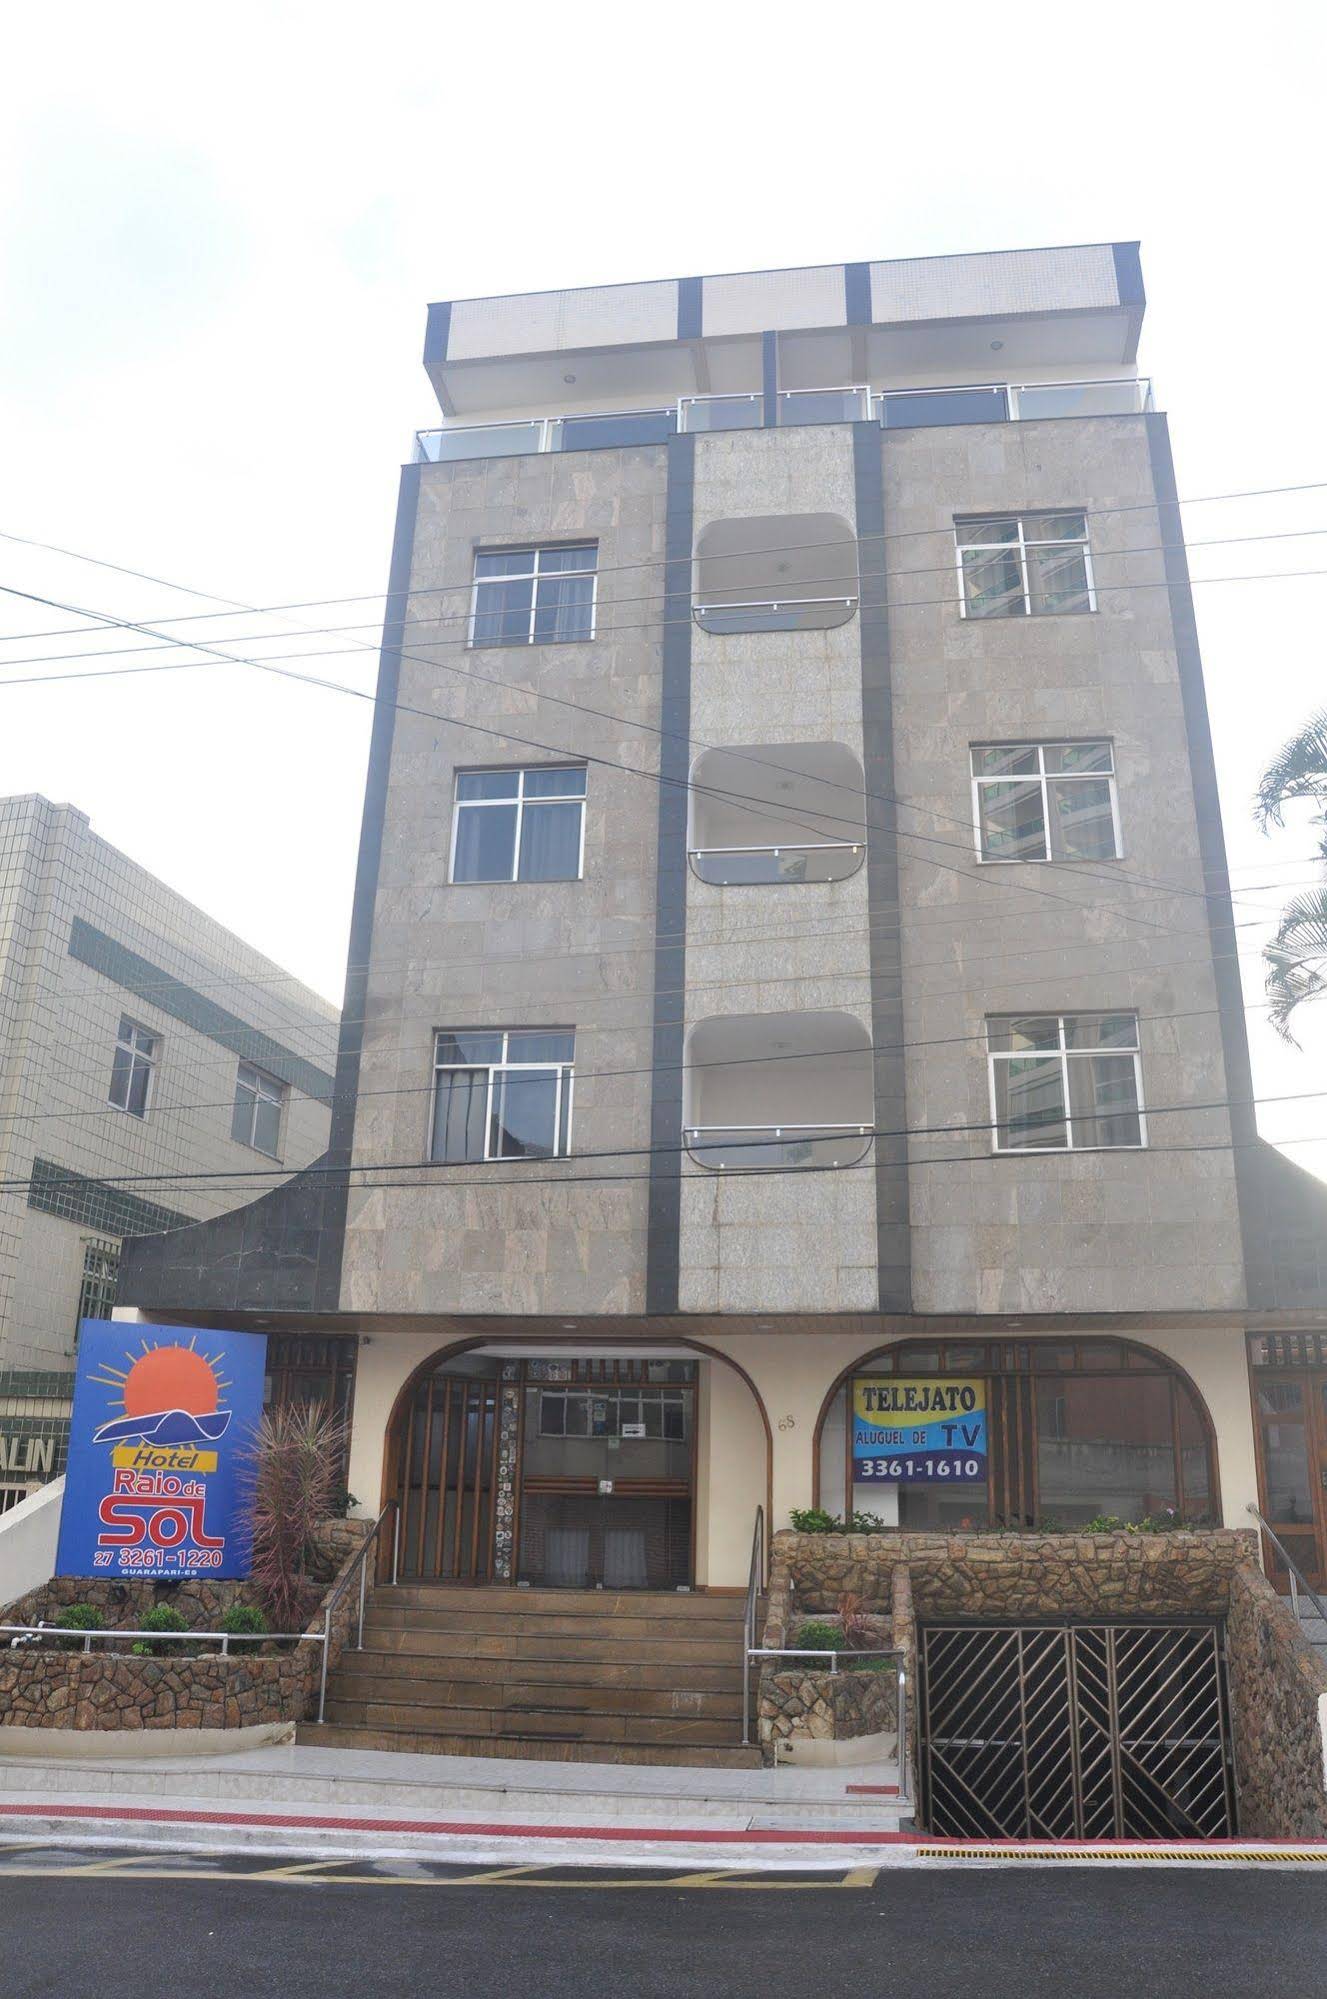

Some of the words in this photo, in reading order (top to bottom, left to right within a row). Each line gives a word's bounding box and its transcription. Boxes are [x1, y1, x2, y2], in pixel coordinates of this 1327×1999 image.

[863, 1386, 976, 1412] TELEJATO
[856, 1431, 904, 1445] ALUGUEL
[912, 1431, 926, 1445] DE
[941, 1424, 981, 1447] TV
[133, 1449, 198, 1469] Hotel
[861, 1460, 979, 1476] 3361-1610
[113, 1468, 182, 1495] Raio
[182, 1480, 206, 1496] de
[94, 1551, 114, 1566] 27
[118, 1548, 223, 1567] 3261-1220
